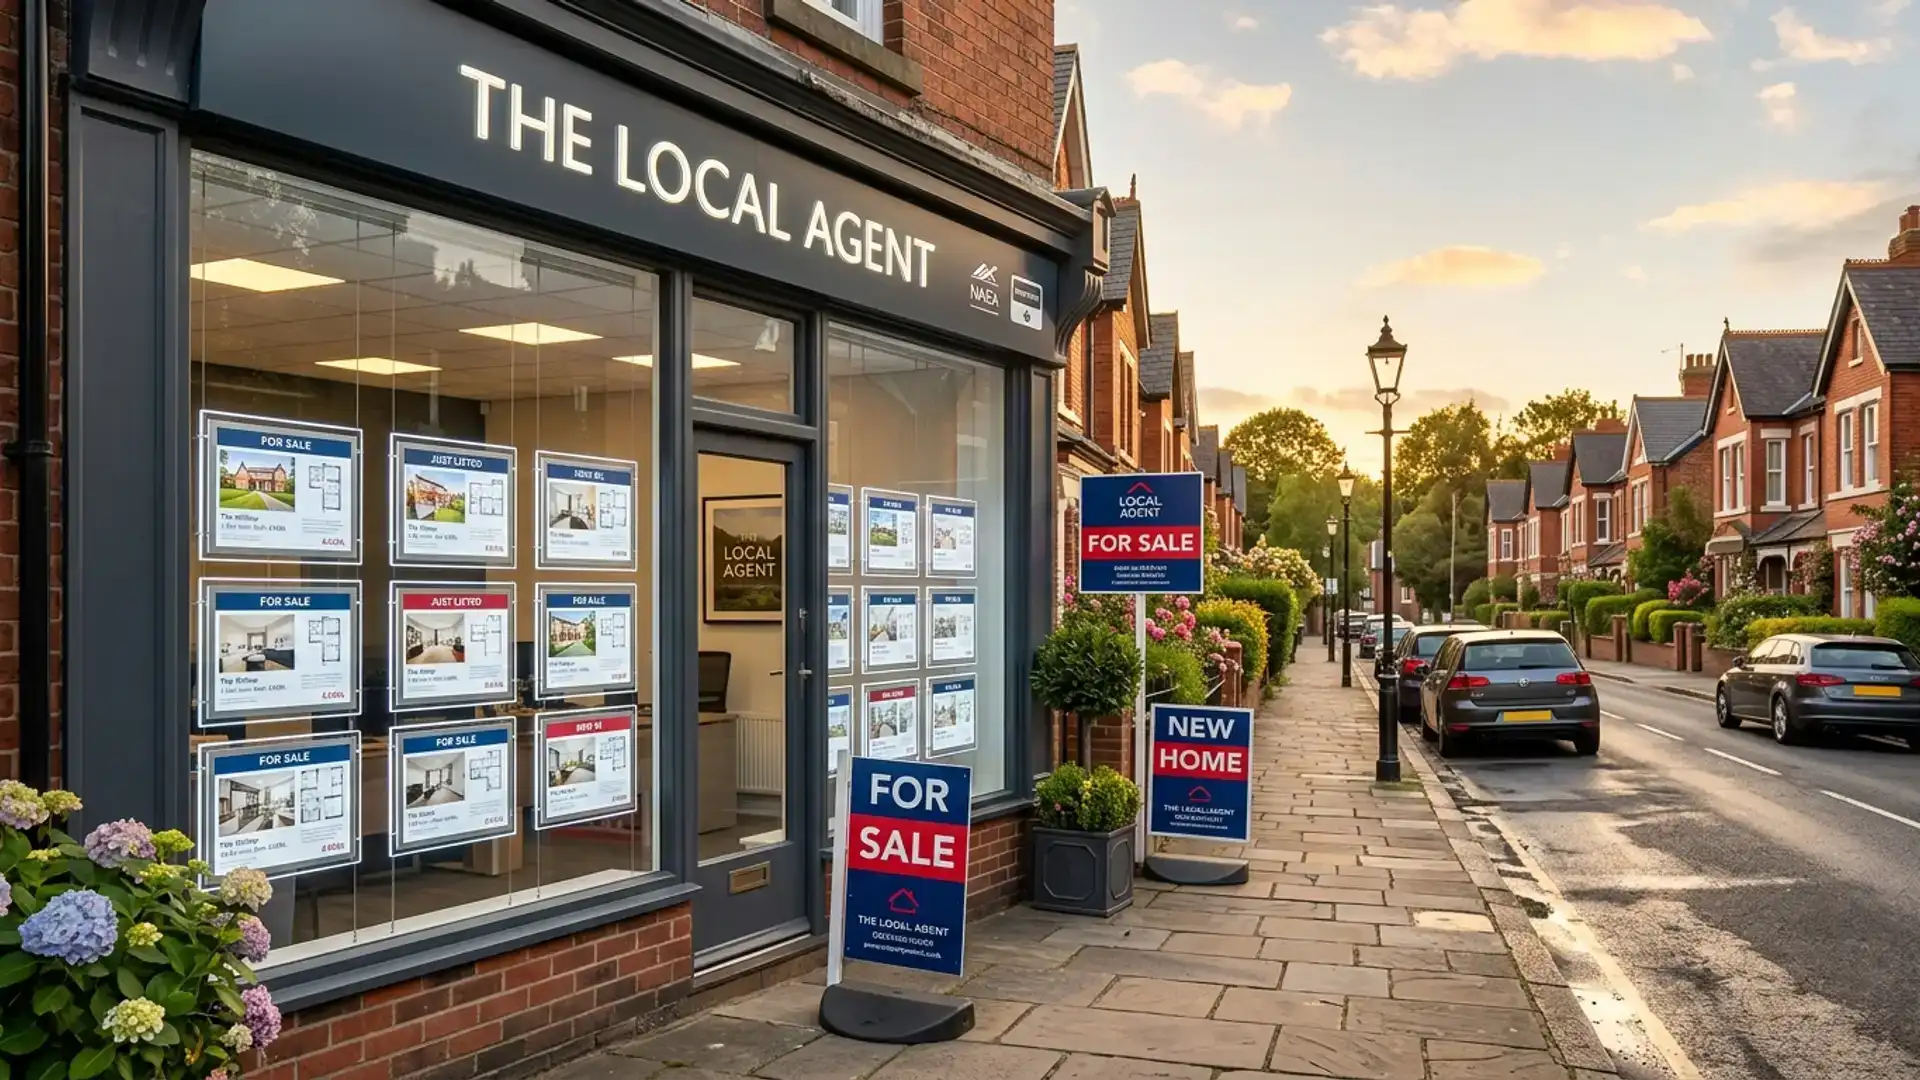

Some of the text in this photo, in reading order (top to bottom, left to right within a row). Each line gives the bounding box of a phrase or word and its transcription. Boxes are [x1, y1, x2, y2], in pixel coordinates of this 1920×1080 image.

[459, 63, 936, 288] THE LOCAL AGENT
[970, 283, 999, 307] NAEA
[285, 438, 312, 451] SALE
[1119, 495, 1163, 507] LOCAL
[1088, 533, 1194, 553] FOR SALE
[724, 545, 776, 560] LOCAL
[723, 562, 776, 578] AGENT
[260, 596, 311, 607] FOR SALE
[1168, 715, 1235, 740] NEW
[436, 737, 453, 747] FOR
[259, 751, 310, 766] FOR SALE
[1160, 747, 1242, 773] HOME
[870, 773, 950, 813] FOR
[859, 826, 955, 869] SALE
[858, 914, 877, 926] THE
